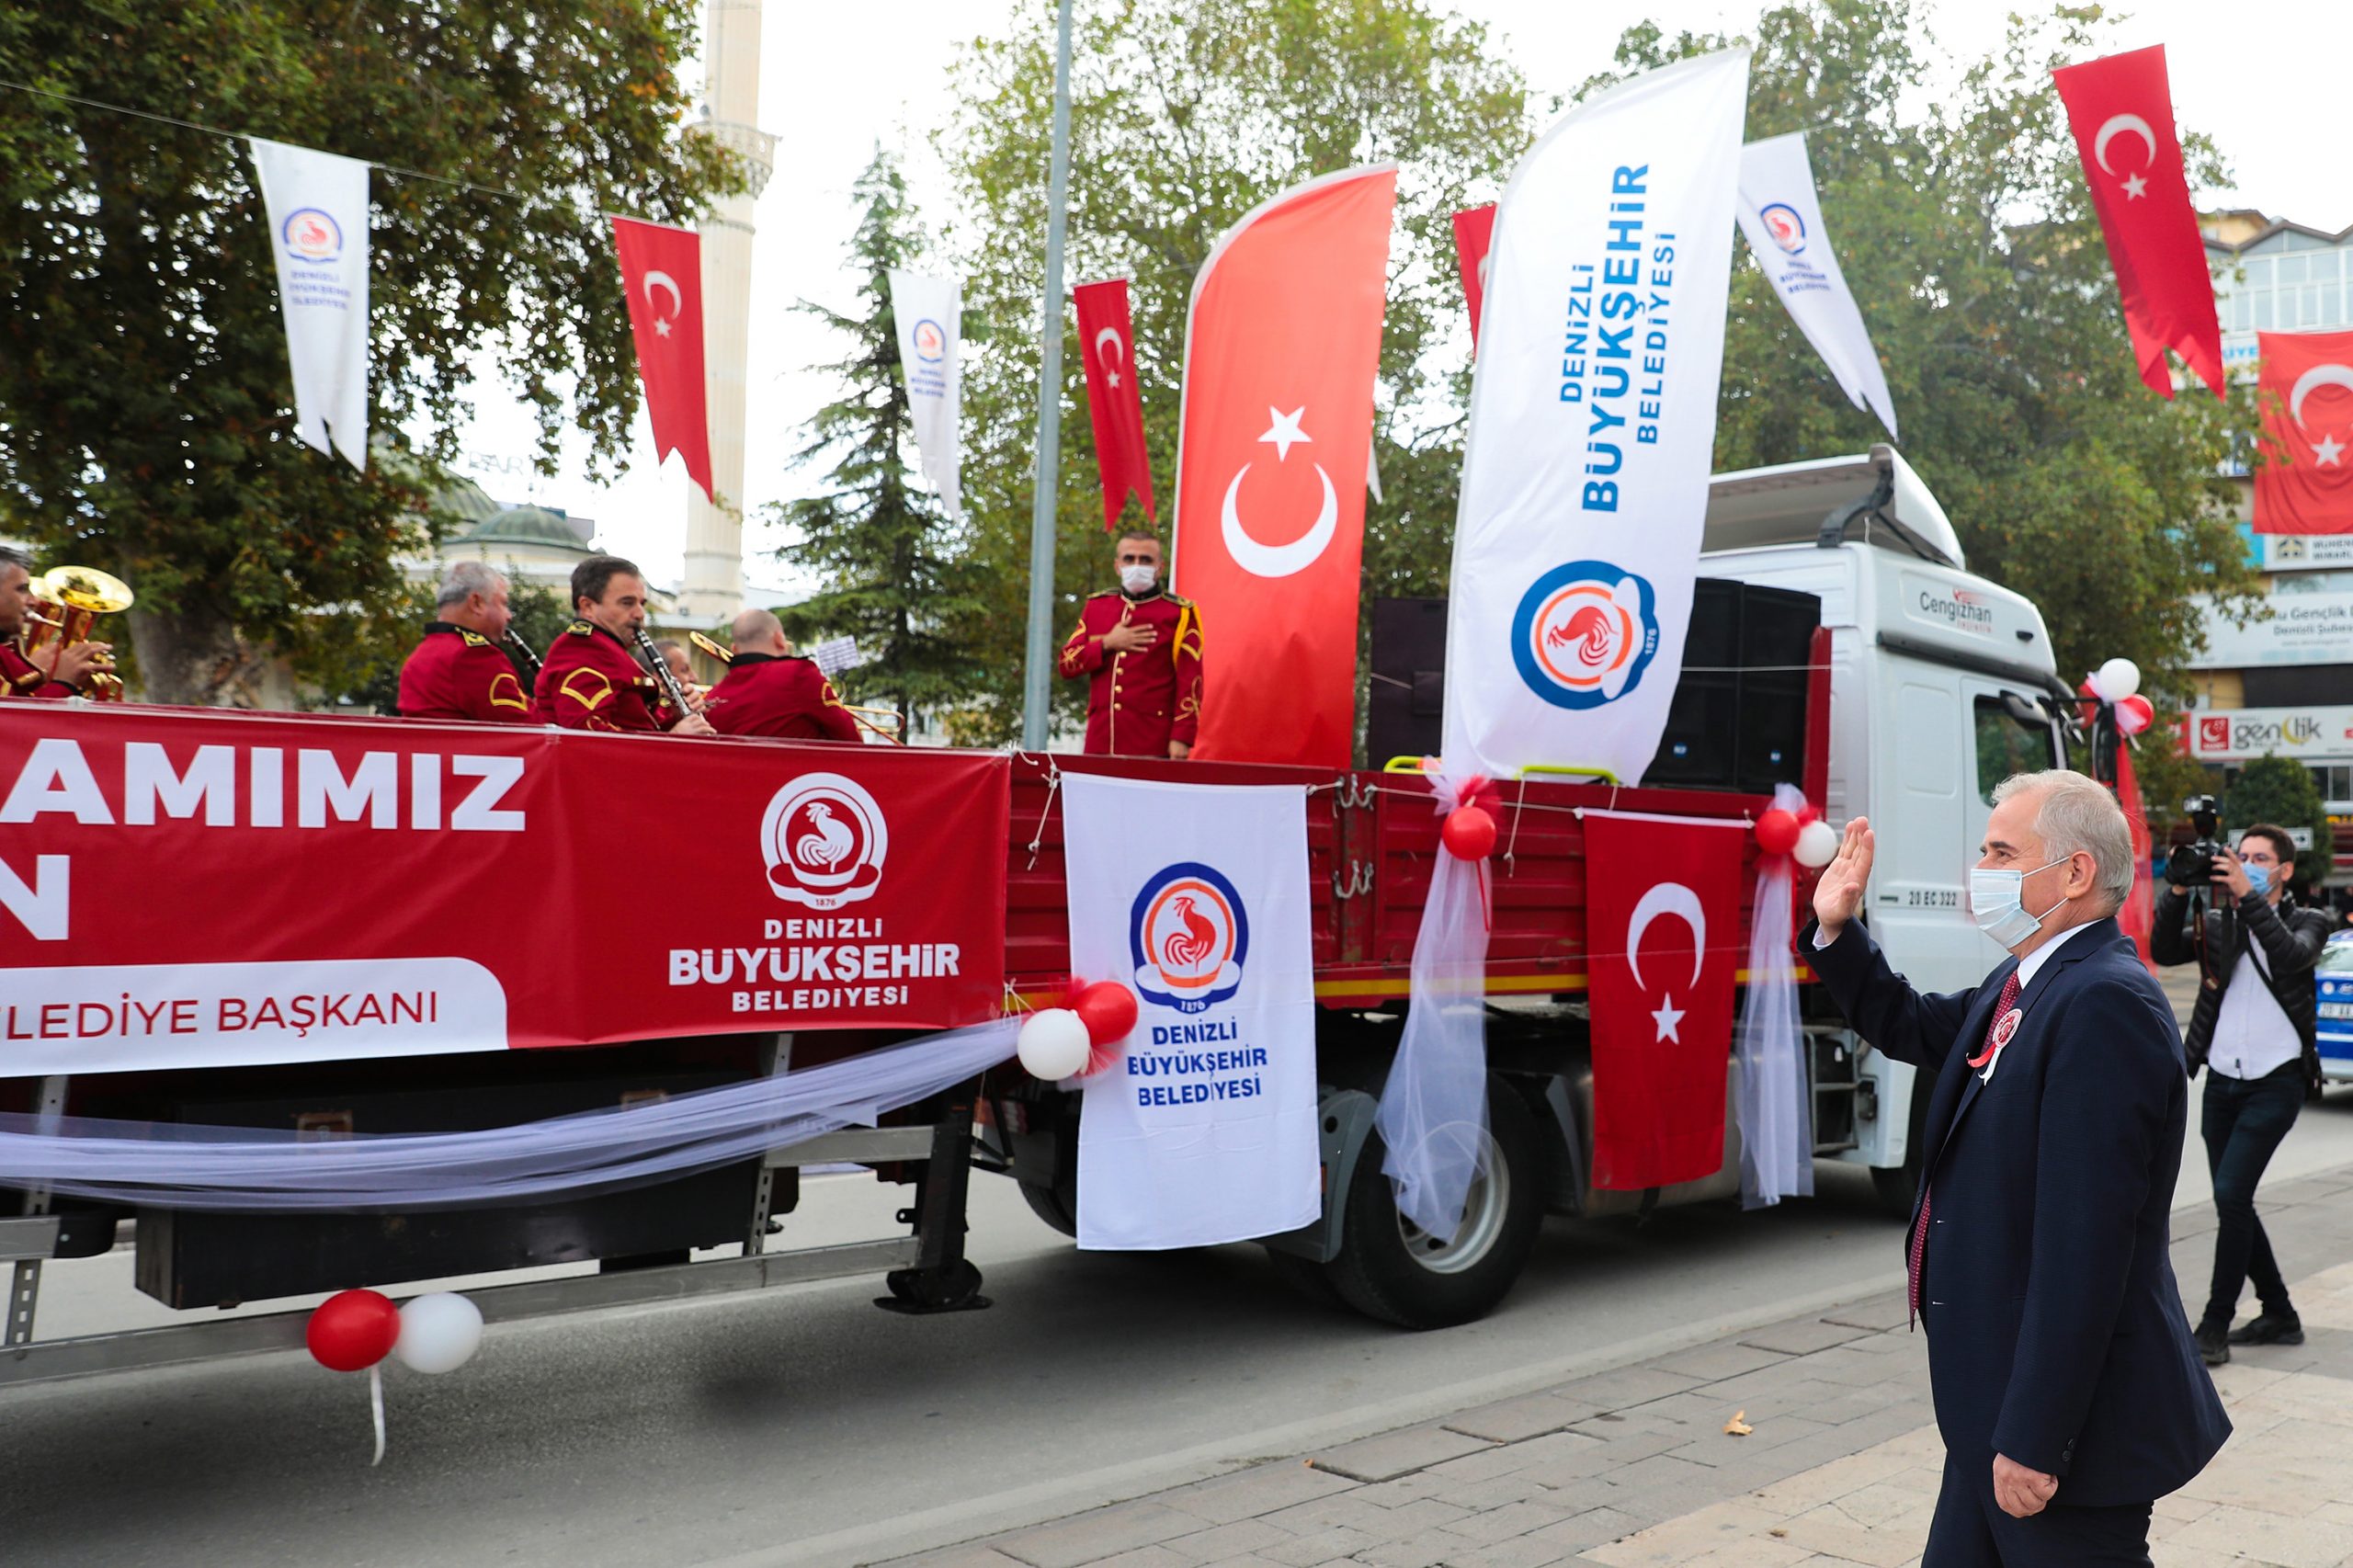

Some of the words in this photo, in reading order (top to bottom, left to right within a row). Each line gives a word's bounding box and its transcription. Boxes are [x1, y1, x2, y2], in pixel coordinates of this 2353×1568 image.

[1560, 264, 1595, 403] DENİZLİ
[1582, 164, 1649, 513] BÜYÜKŞEHİR
[1637, 233, 1676, 444] BELEDİYESİ
[1918, 591, 1992, 623] Cengizhan
[0, 738, 526, 832] AMIMIZ
[815, 897, 837, 907] 1876
[1909, 891, 1920, 905] 20
[764, 917, 883, 939] DENİZLİ
[668, 943, 960, 986] BÜYÜKŞEHİR
[732, 985, 909, 1012] BELEDİYESİ
[1180, 999, 1207, 1012] 1876
[0, 993, 199, 1040] LEDİYE
[217, 991, 438, 1038] BAŞKANI
[1152, 1016, 1238, 1045] DENİZLİ
[1127, 1044, 1268, 1078] BÜYÜKŞEHİR
